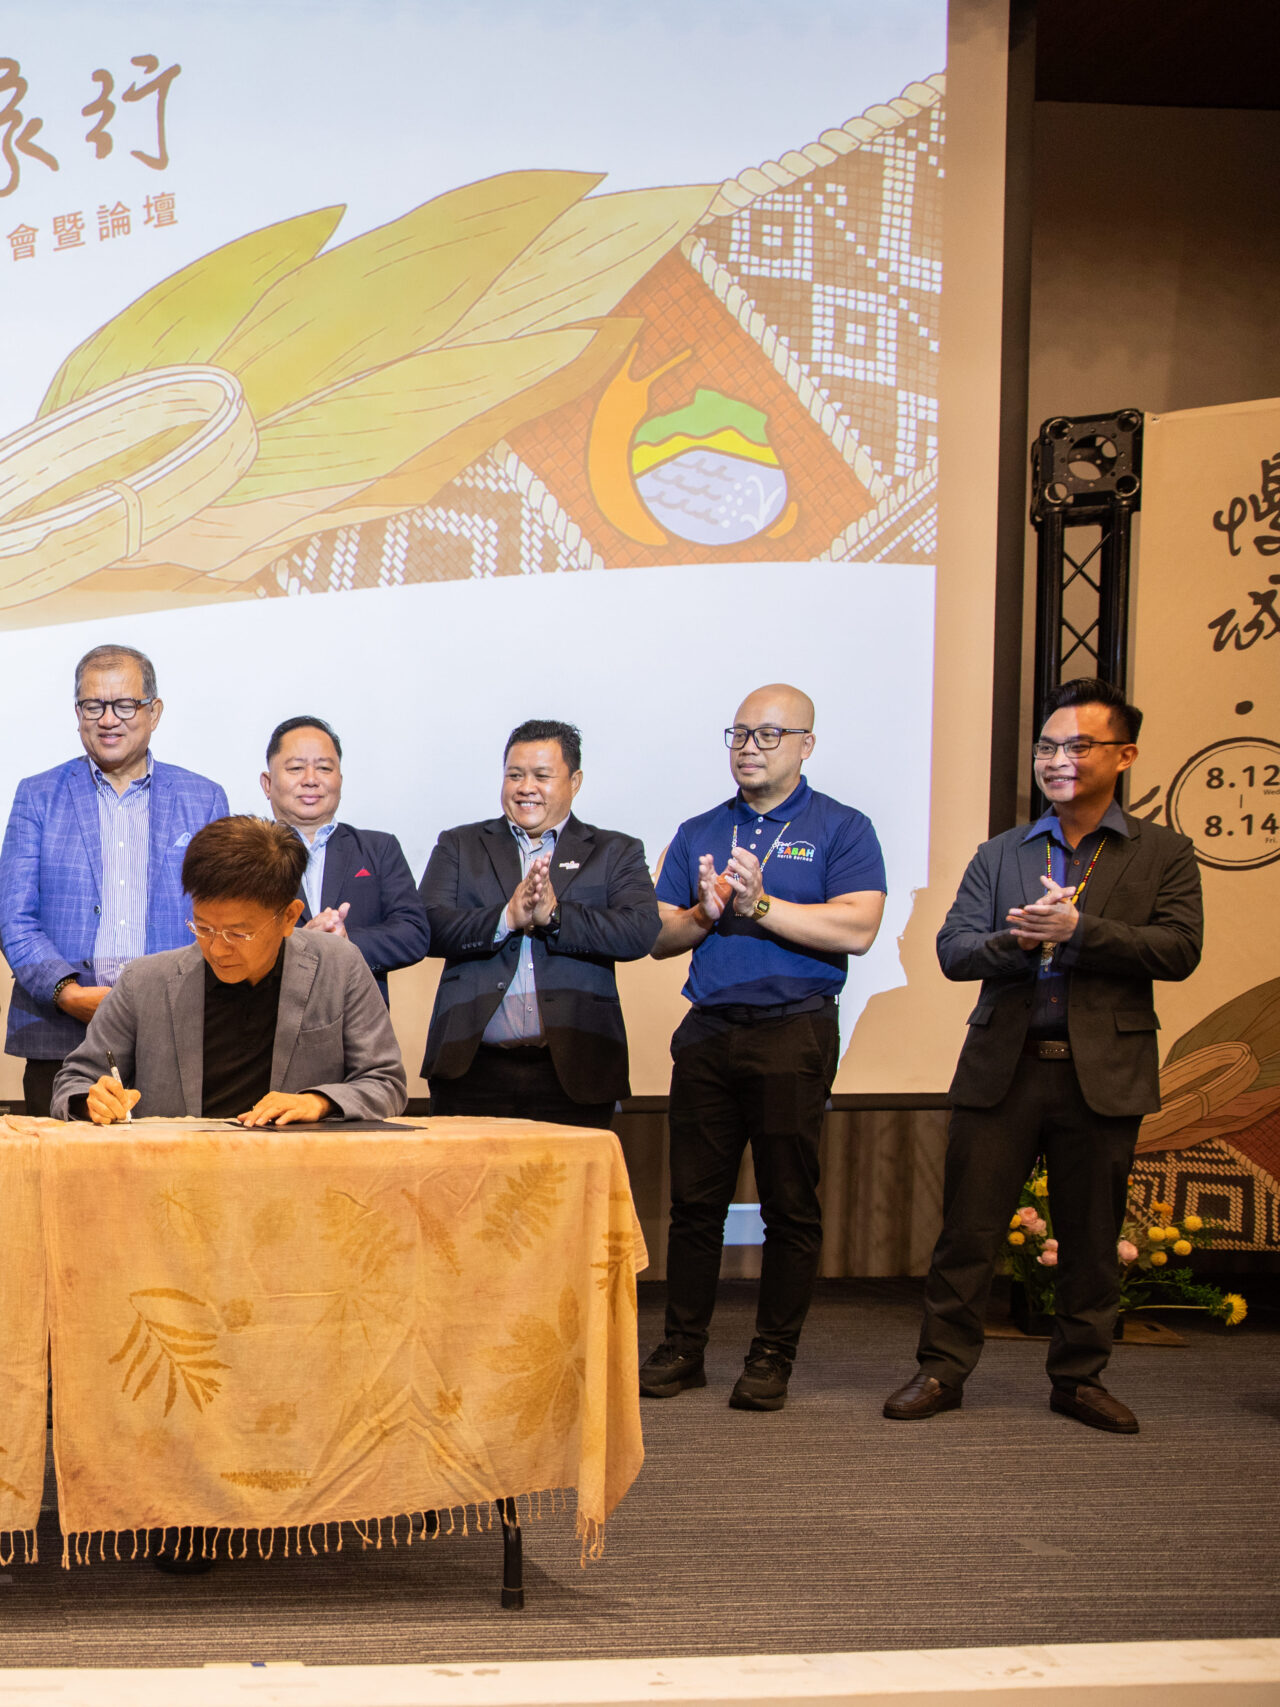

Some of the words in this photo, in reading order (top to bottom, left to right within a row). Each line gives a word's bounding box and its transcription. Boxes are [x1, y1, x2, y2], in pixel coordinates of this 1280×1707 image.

[1206, 764, 1280, 789] 8.12
[1204, 812, 1280, 837] 8.14
[777, 846, 815, 858] SABAH
